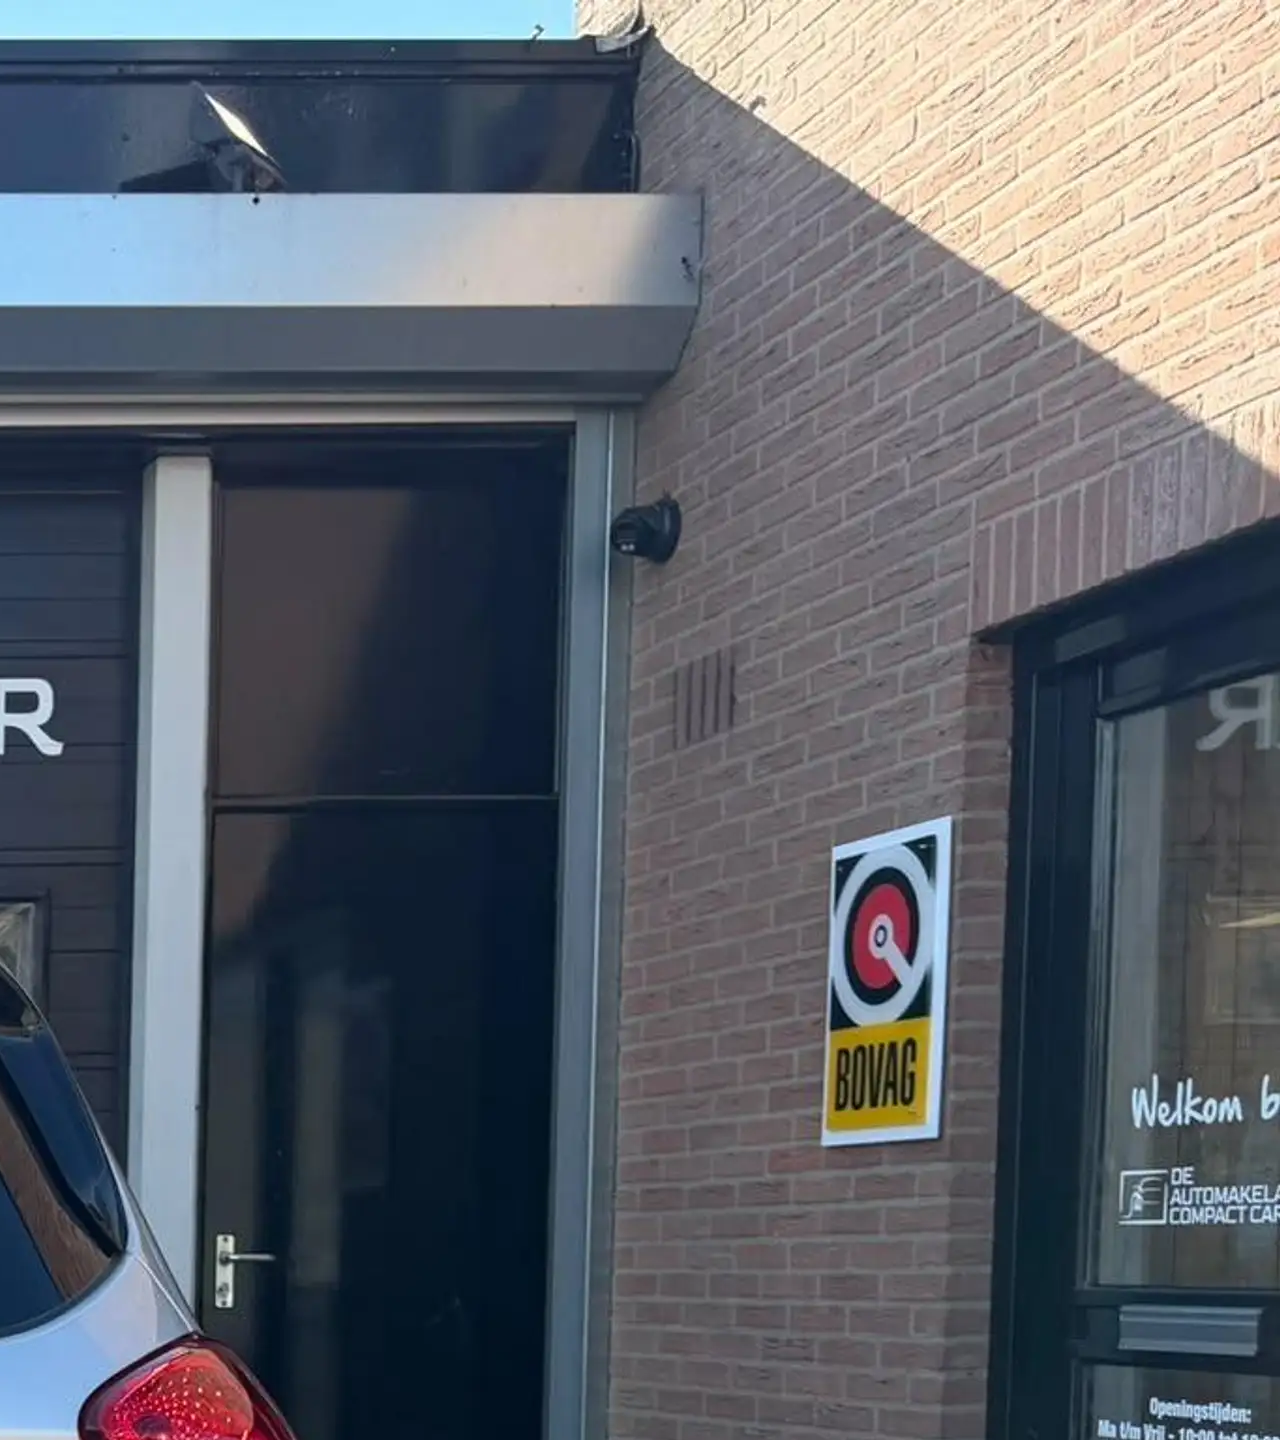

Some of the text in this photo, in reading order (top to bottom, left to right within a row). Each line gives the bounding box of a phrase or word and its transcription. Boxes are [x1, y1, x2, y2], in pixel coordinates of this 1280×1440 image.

[834, 1037, 917, 1112] BOVAG
[1131, 1073, 1244, 1128] Welkom
[1171, 1166, 1195, 1185] DE
[1169, 1205, 1248, 1224] COMPACT
[1149, 1397, 1252, 1425] Openingstijden:
[1097, 1419, 1116, 1438] Ma
